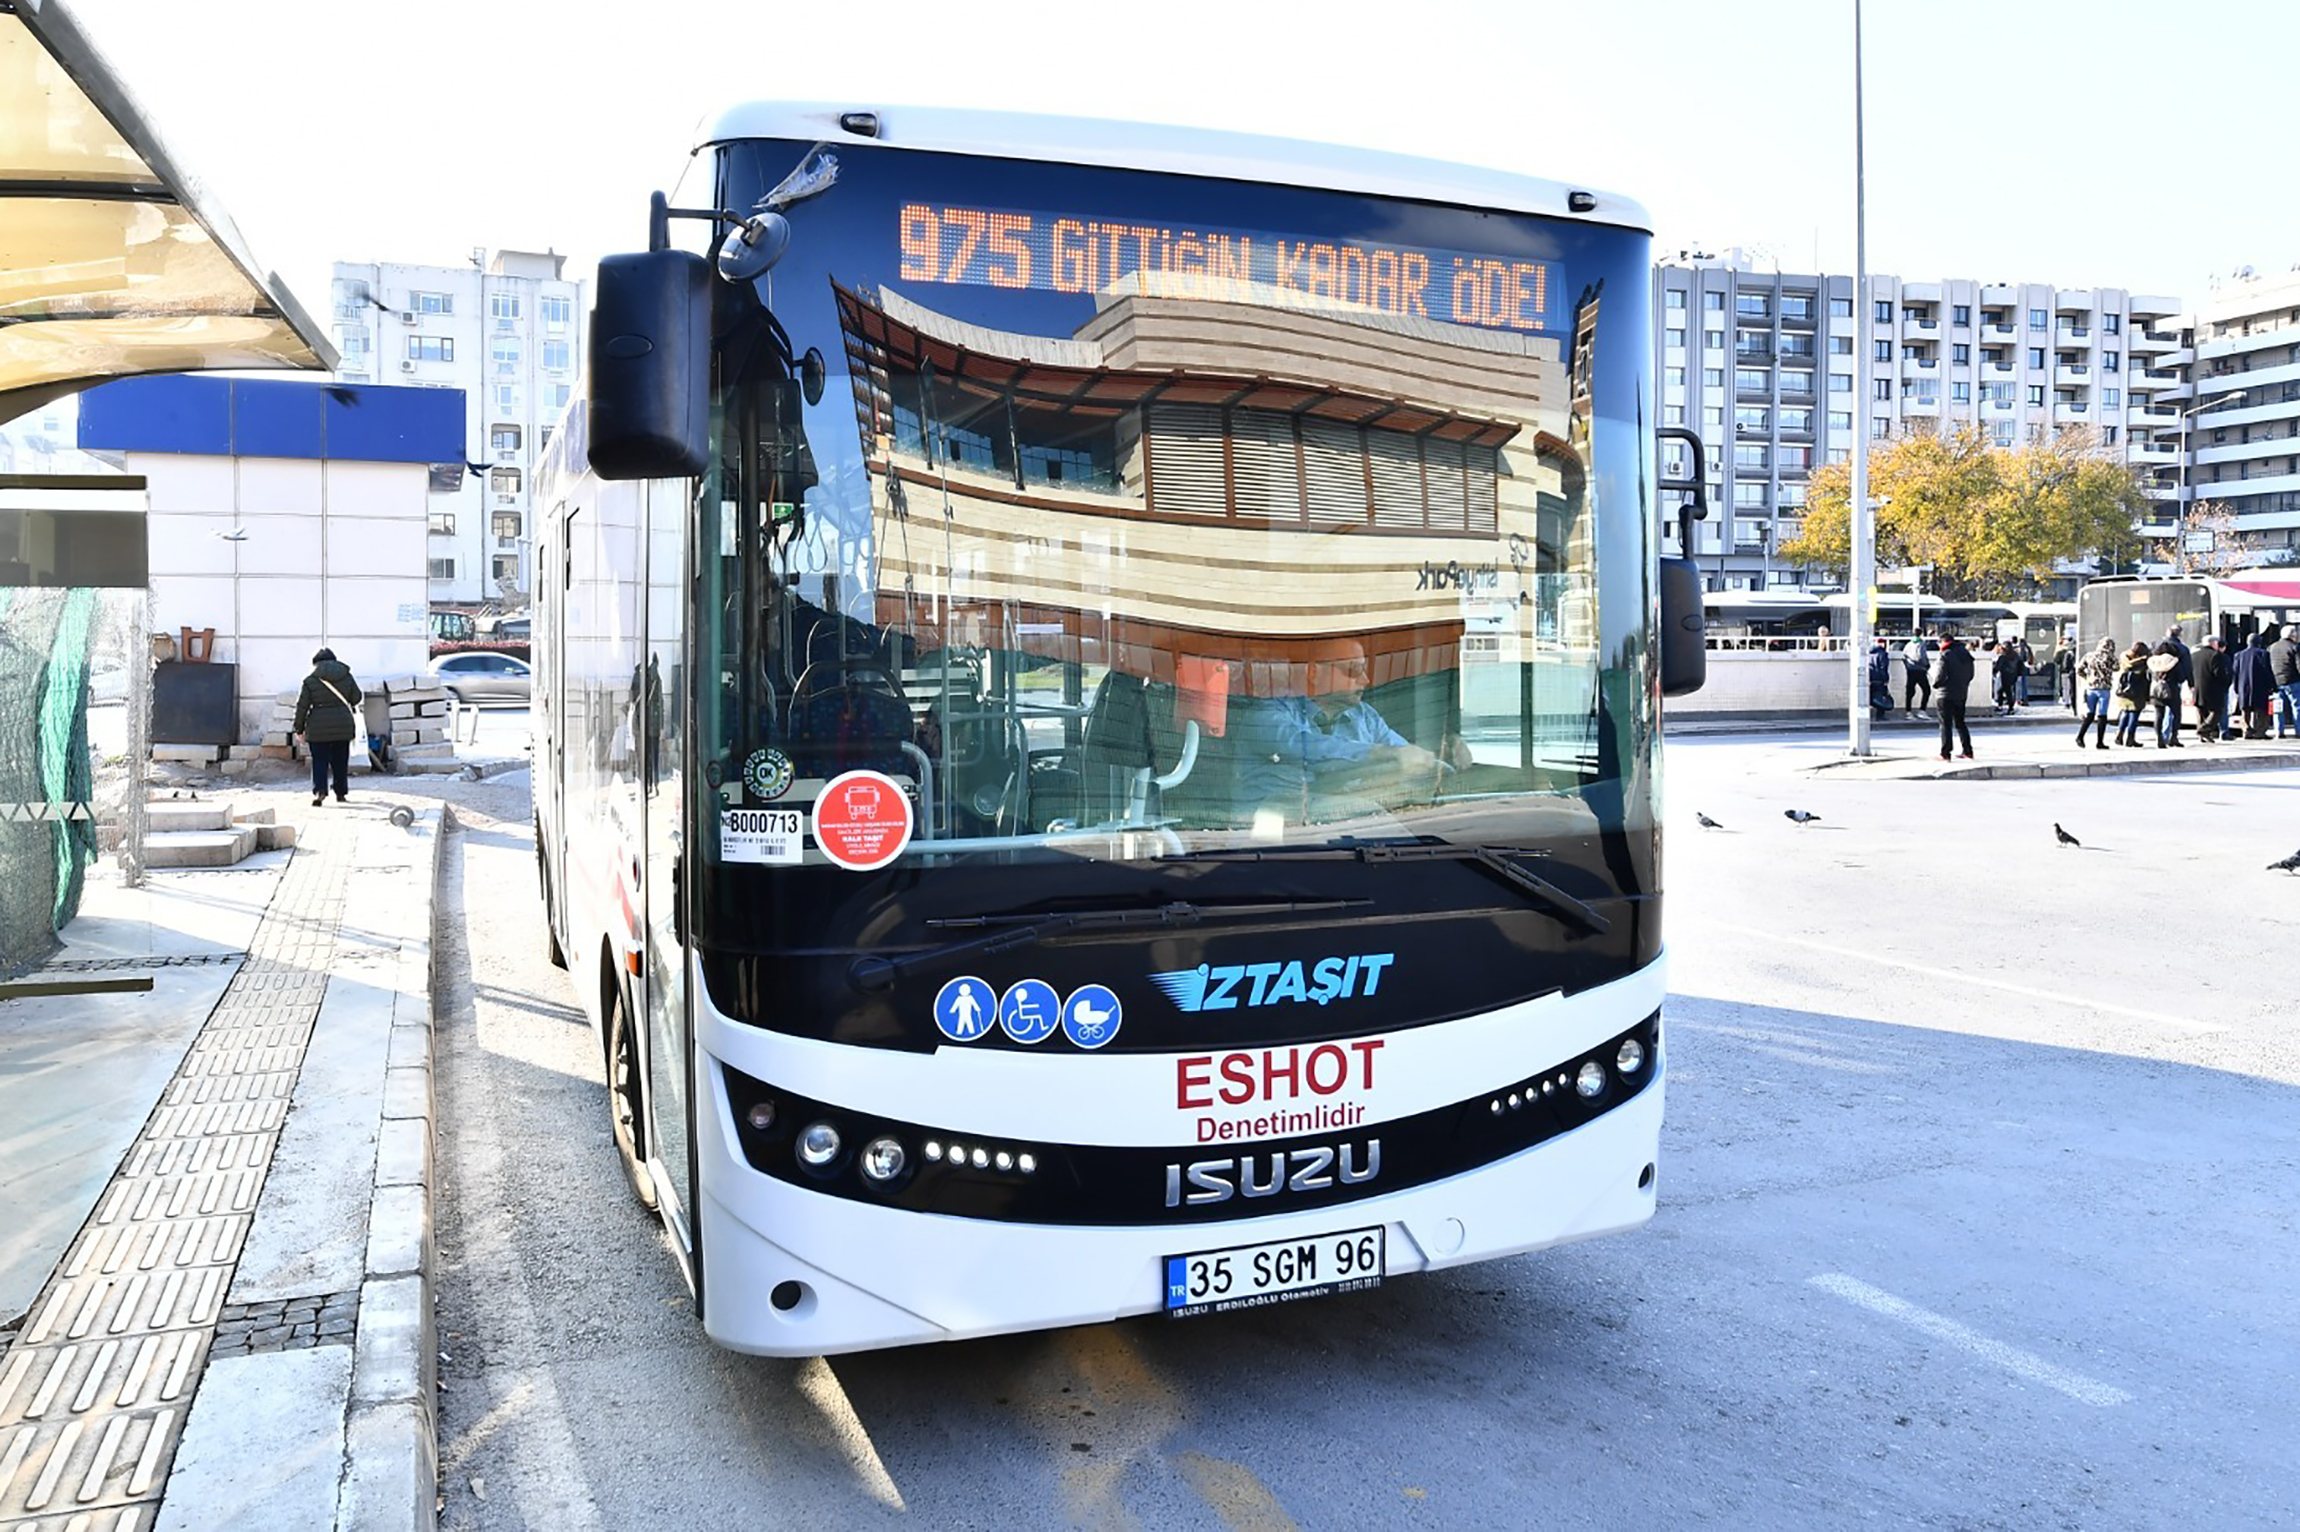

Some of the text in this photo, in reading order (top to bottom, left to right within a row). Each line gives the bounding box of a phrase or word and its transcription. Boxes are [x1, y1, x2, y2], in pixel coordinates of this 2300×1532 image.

[900, 204, 1032, 288] 975
[1277, 240, 1429, 318] KADAR
[730, 812, 798, 833] B000713
[1165, 953, 1394, 1012] İZTAŞIT
[1176, 1039, 1385, 1110] ESHOT
[1197, 1103, 1366, 1142] Denetimlidir
[1165, 1139, 1380, 1208] ISUZU
[1170, 1284, 1185, 1297] TR
[1189, 1256, 1233, 1298] 35
[1253, 1244, 1317, 1287] SGM
[1335, 1236, 1375, 1275] 96
